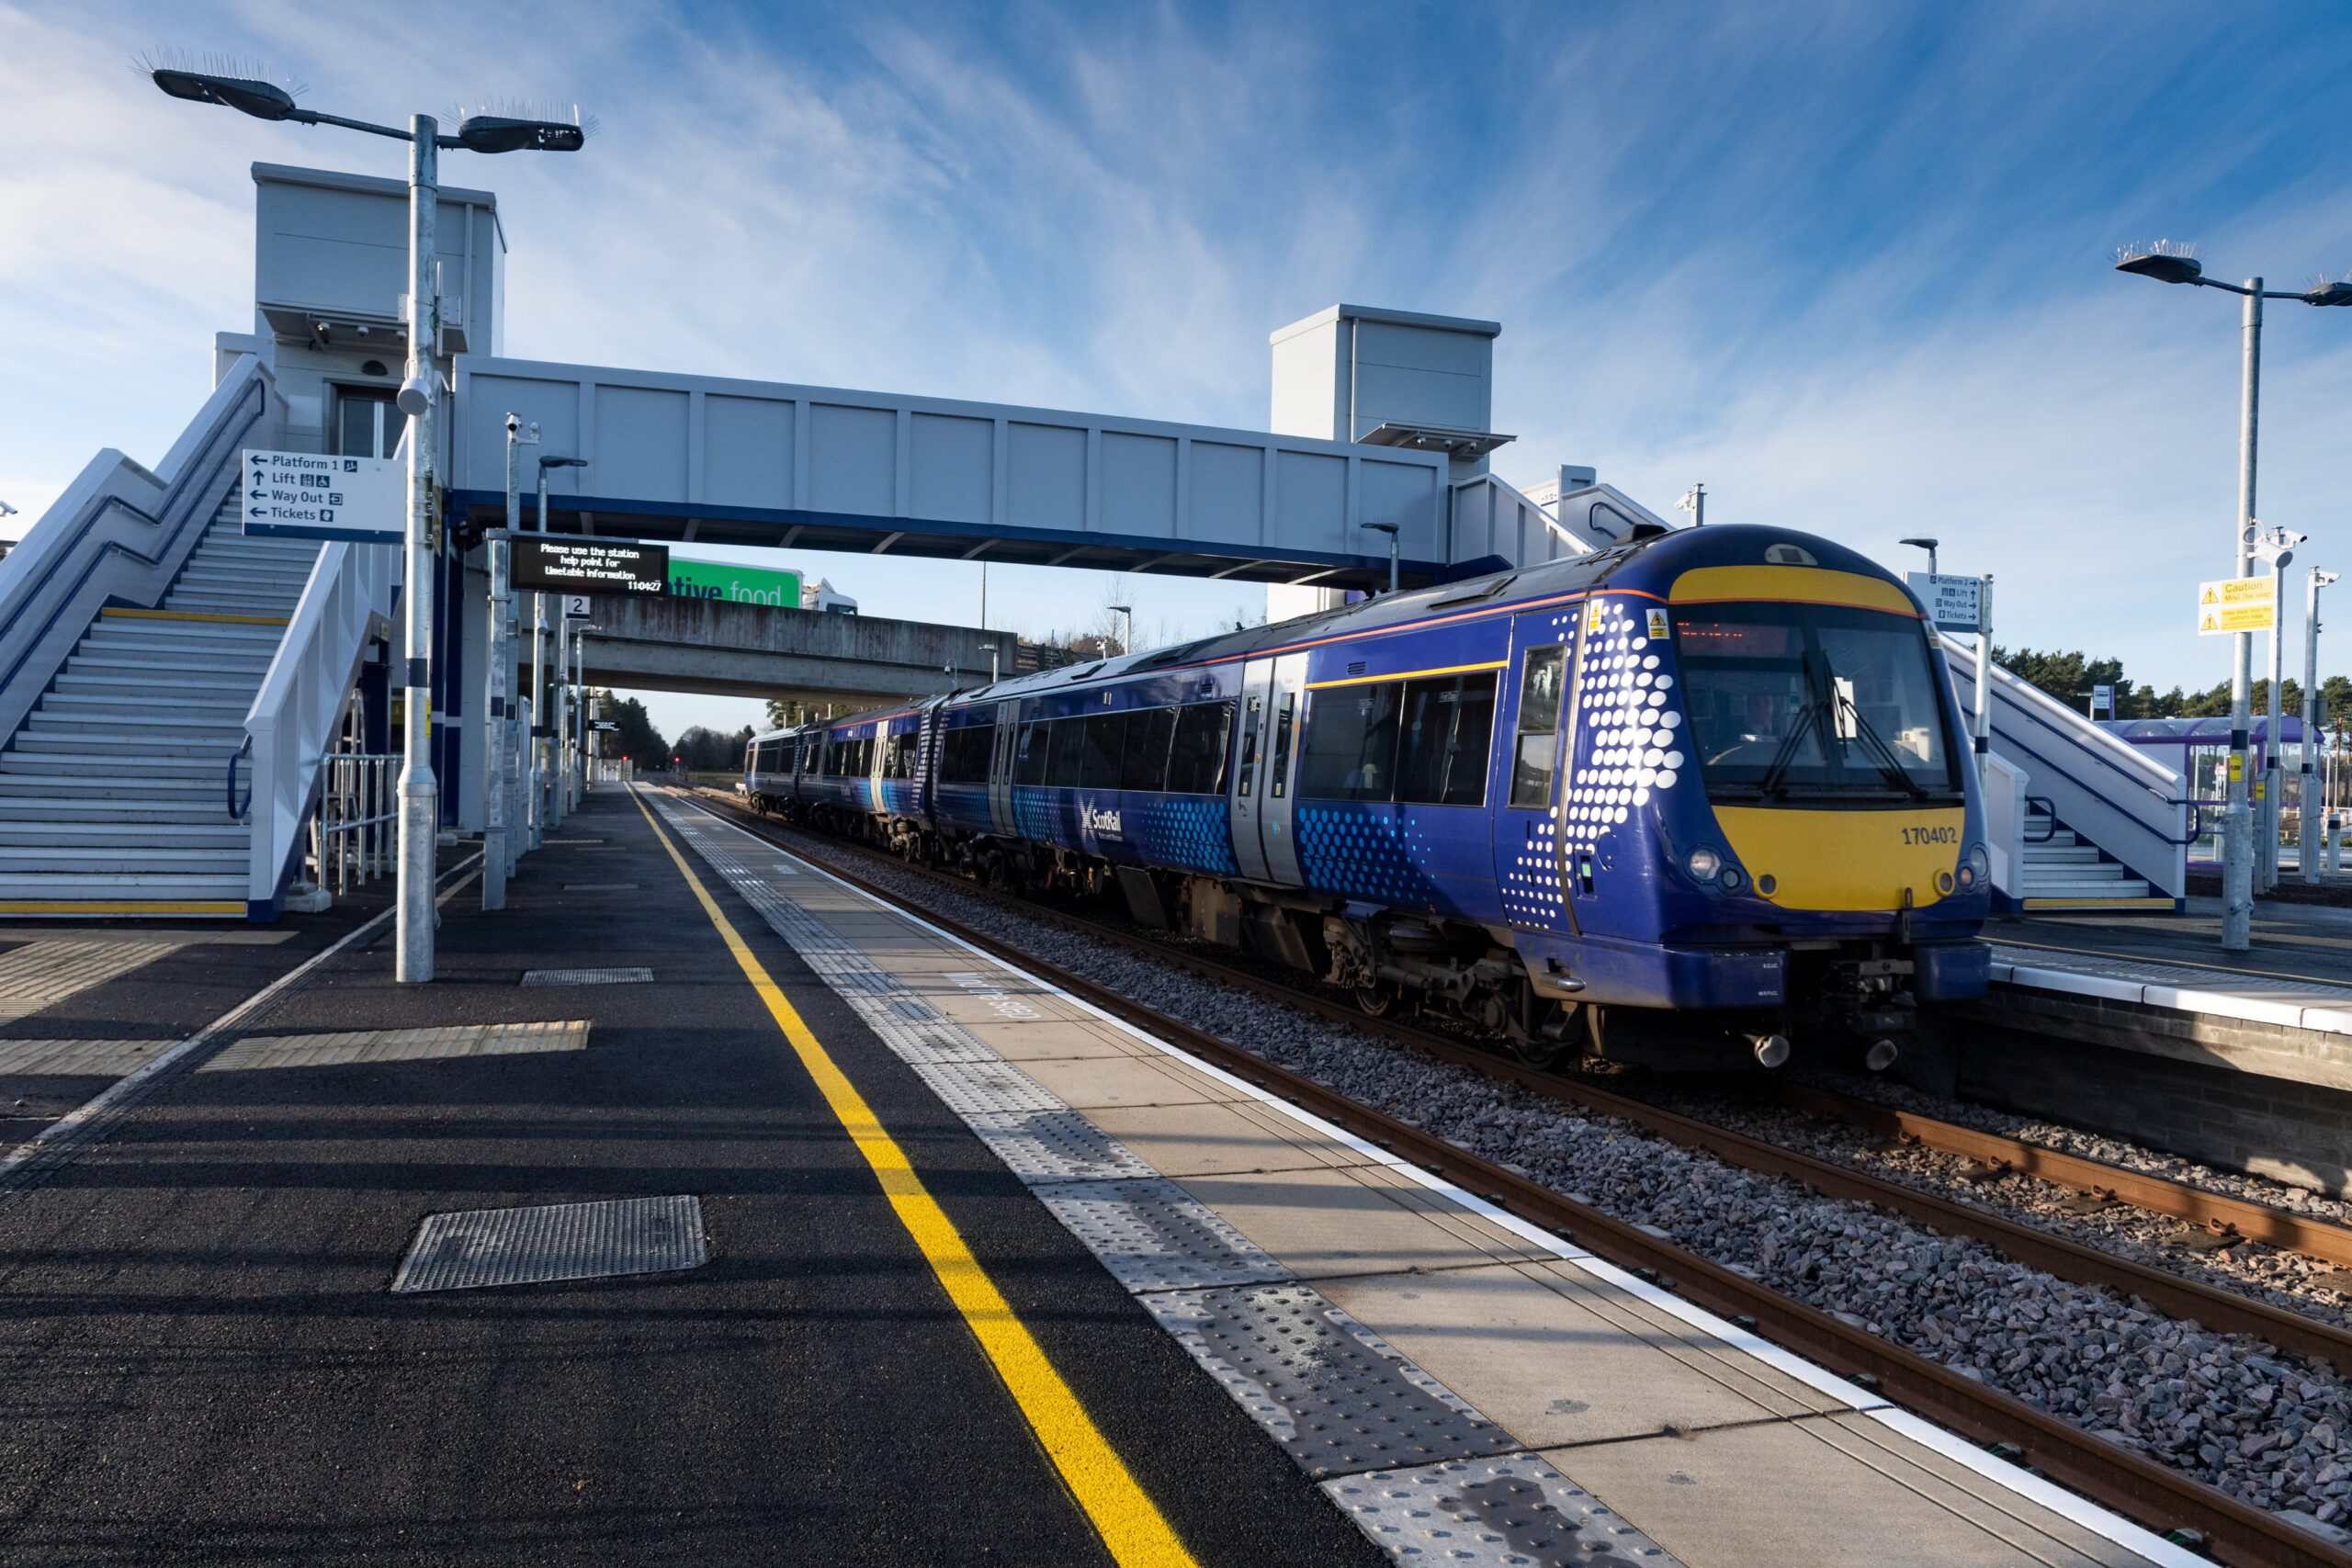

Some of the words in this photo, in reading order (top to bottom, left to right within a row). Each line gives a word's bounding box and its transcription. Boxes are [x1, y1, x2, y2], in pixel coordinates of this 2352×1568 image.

[273, 456, 327, 469] Platform
[332, 461, 337, 469] 1
[273, 472, 295, 484] Lift
[272, 490, 297, 503] Way
[300, 491, 323, 503] Out
[271, 507, 315, 520] Tickets
[541, 544, 569, 554] Please
[571, 547, 587, 555] use
[591, 547, 605, 556] the
[608, 548, 639, 558] station
[560, 556, 578, 566] help
[581, 558, 603, 567] point
[605, 558, 620, 567] for
[545, 566, 584, 577] timetable
[587, 569, 635, 580] information
[628, 581, 662, 591] 11:04:27
[1939, 577, 1963, 585] Platform
[2225, 582, 2263, 592] Caution
[730, 581, 781, 606] food
[1957, 589, 1968, 597] Lift
[573, 598, 582, 612] 2
[1944, 600, 1955, 609] Way
[1947, 611, 1967, 620] Tickets
[1092, 809, 1122, 831] ScotRail
[1901, 827, 1958, 845] 170402
[988, 1001, 1041, 1019] step
